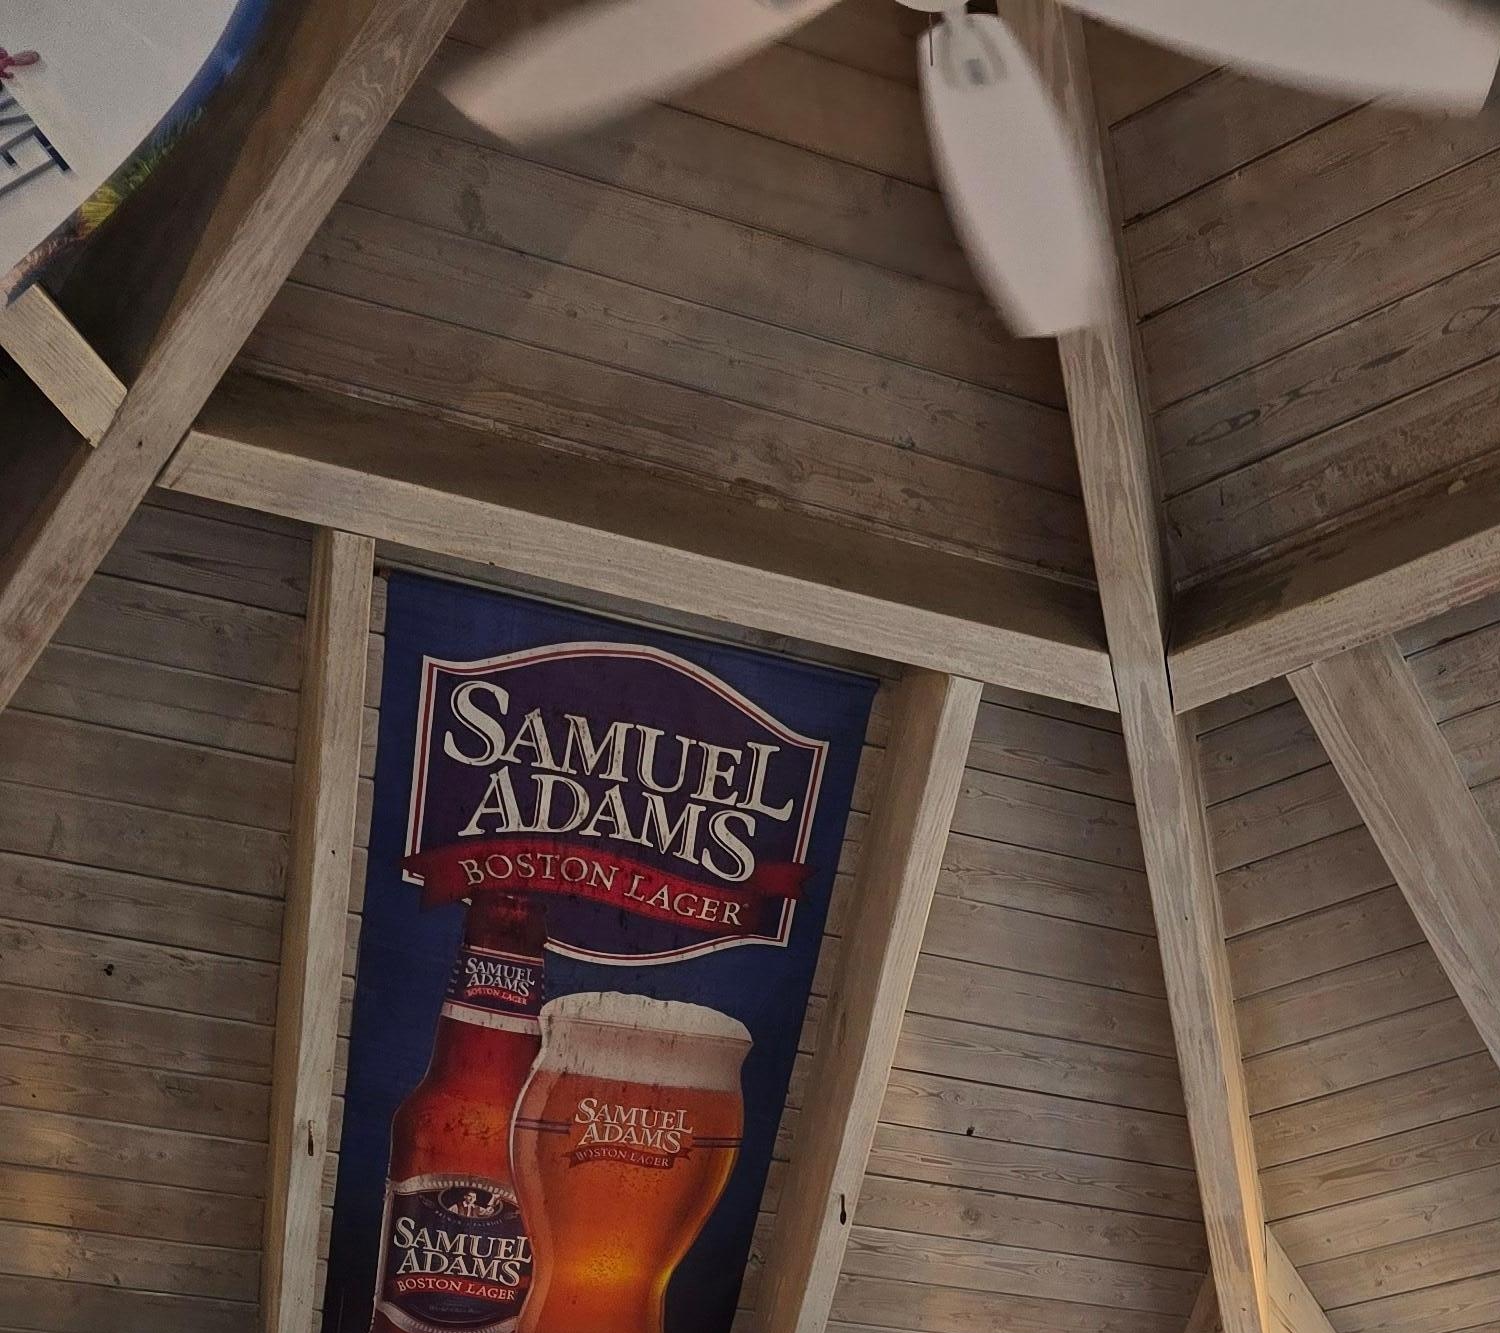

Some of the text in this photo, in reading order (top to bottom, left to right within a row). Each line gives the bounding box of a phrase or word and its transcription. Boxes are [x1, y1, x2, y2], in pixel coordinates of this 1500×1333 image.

[443, 680, 795, 882] SAMUEL ADAMS
[458, 853, 742, 927] BOSTON LAGER
[465, 957, 535, 997] SAMUEL ADAMS
[574, 1098, 694, 1154] SAMUEL ADAMS
[576, 1147, 670, 1168] BOSTON LAGER
[393, 1217, 533, 1264] SAMUEL
[396, 1249, 521, 1288] ADAMS
[397, 1276, 516, 1302] BOSTON LAGER
